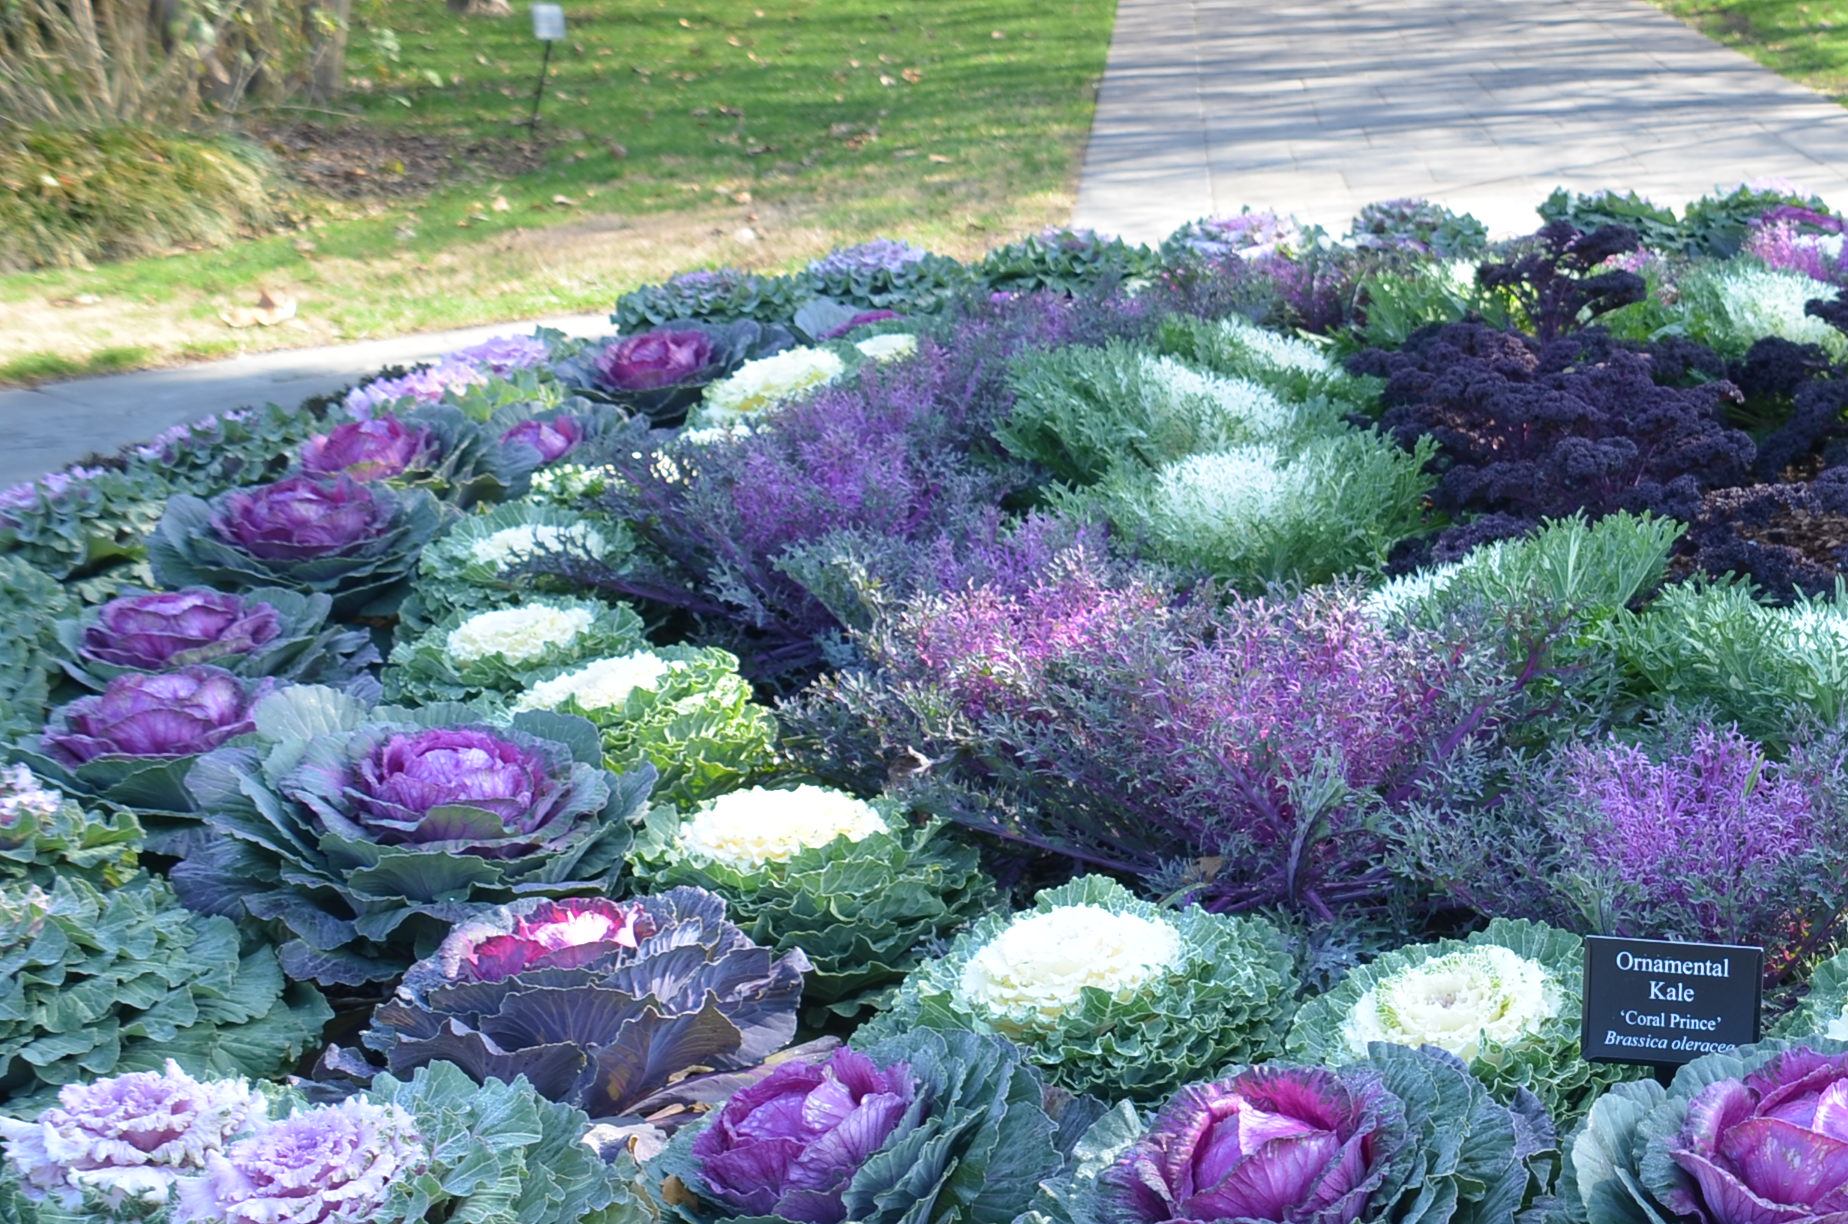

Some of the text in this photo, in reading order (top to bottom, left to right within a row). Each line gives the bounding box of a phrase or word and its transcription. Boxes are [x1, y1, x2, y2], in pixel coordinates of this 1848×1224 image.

[1616, 952, 1729, 978] Ornamental
[1649, 981, 1695, 1002] Kale
[1604, 1031, 1667, 1049] Brassica
